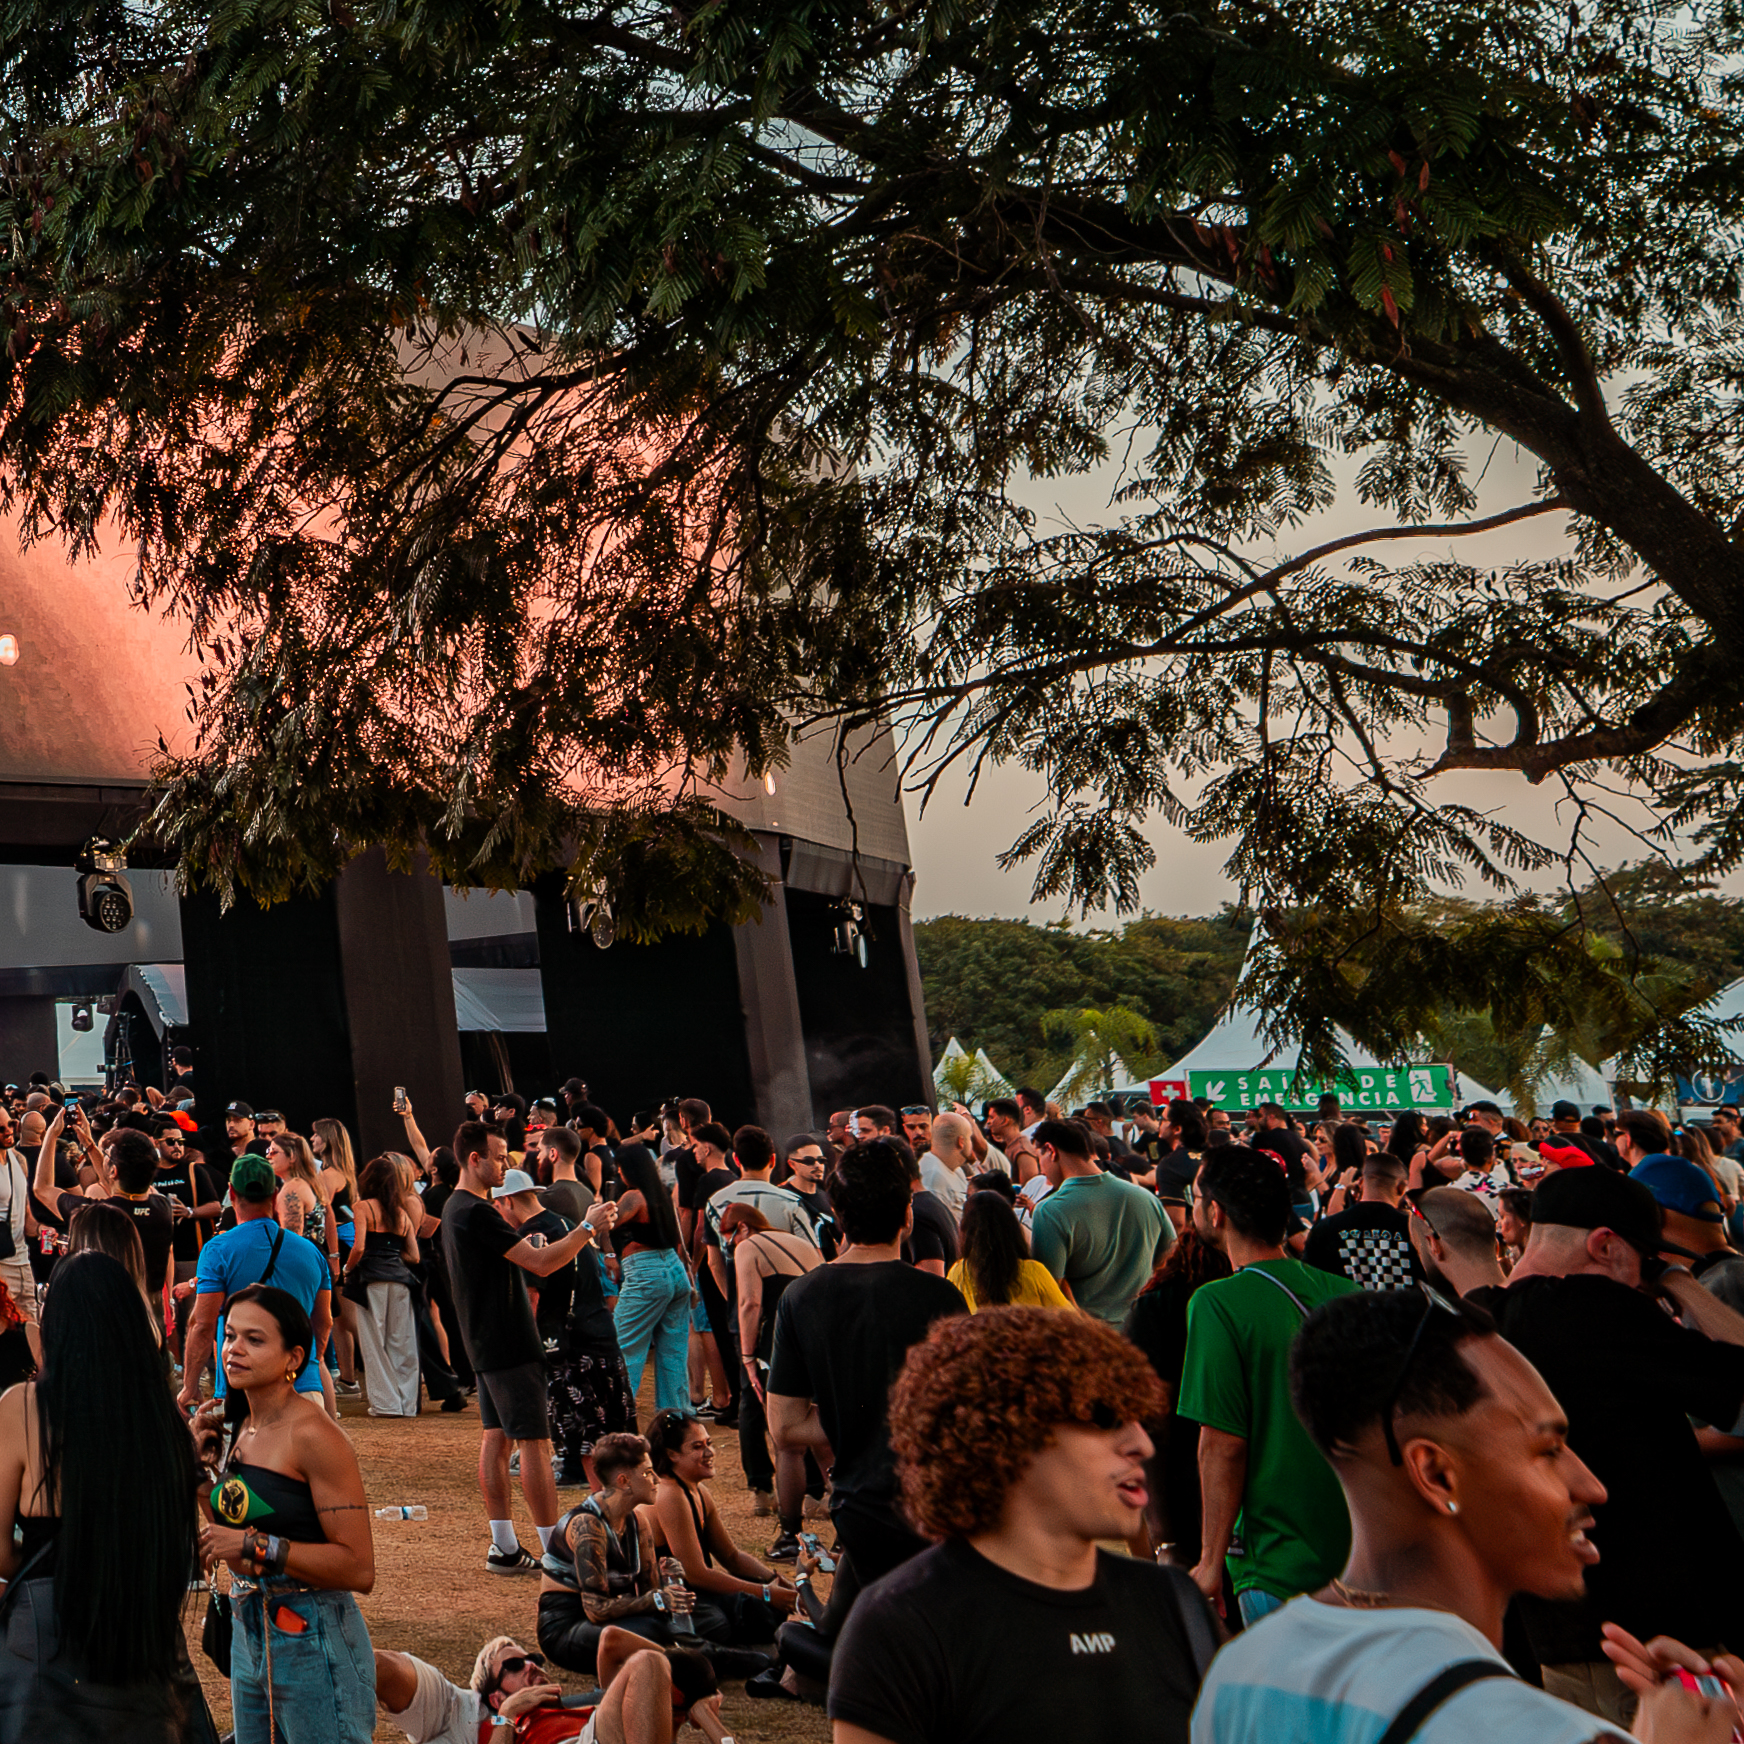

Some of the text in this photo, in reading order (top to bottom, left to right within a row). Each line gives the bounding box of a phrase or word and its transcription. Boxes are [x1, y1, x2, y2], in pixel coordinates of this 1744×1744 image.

[1361, 1074, 1397, 1089] DE
[1240, 1090, 1400, 1106] EMEGNCIA
[133, 1206, 151, 1216] UFC
